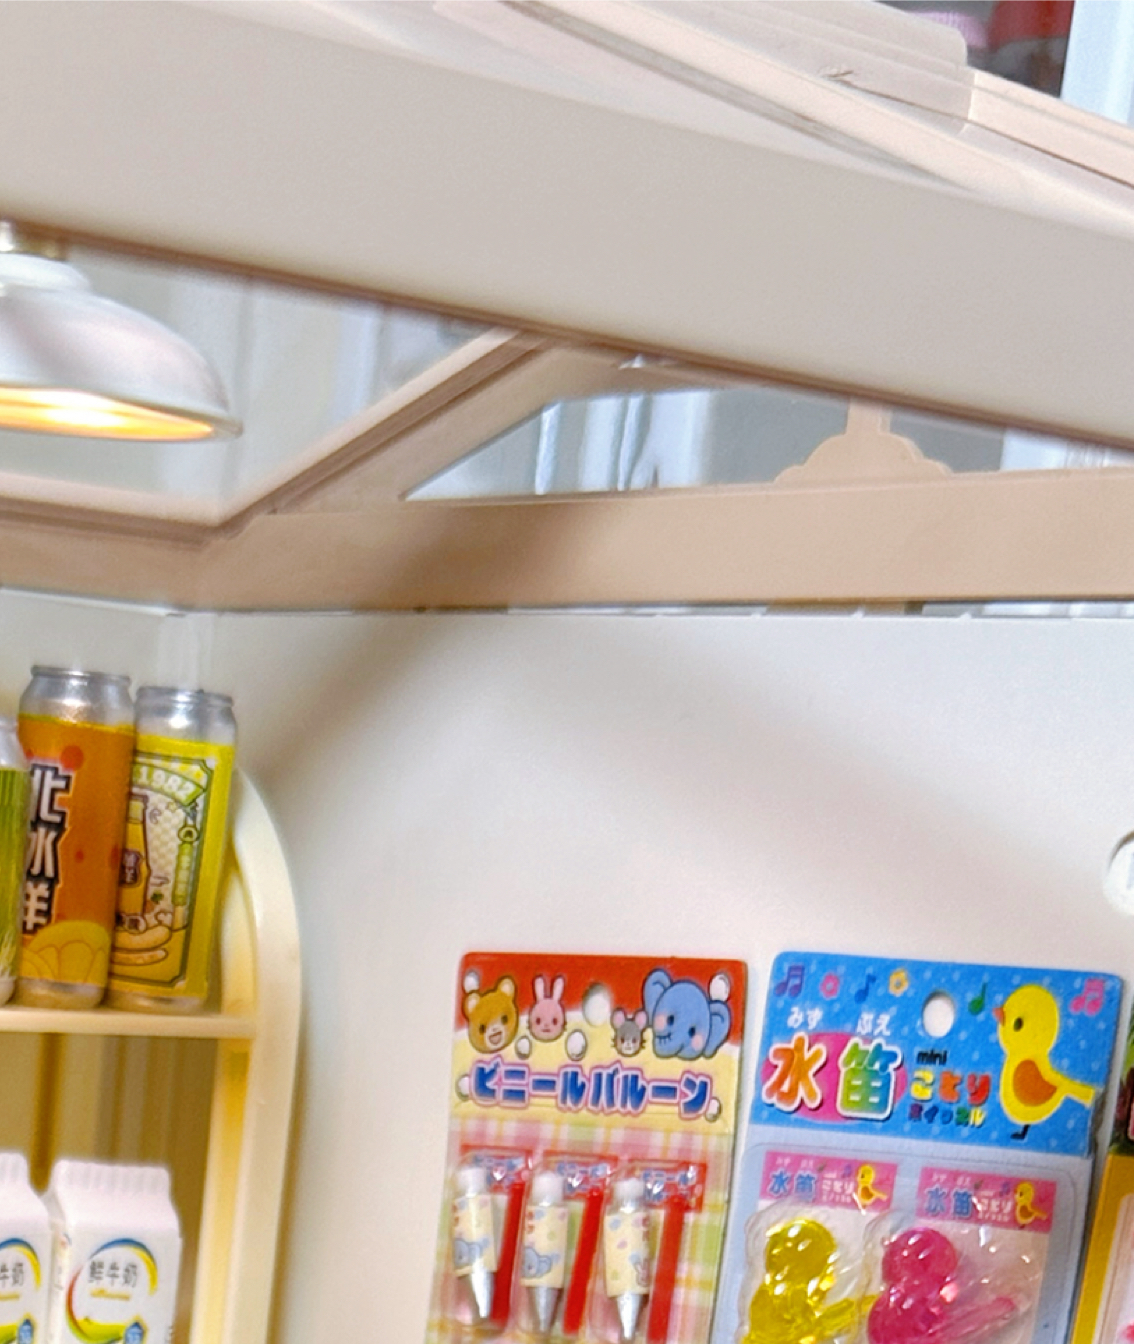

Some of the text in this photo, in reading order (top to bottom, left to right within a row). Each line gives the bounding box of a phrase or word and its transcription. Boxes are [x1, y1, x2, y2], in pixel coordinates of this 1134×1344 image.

[137, 766, 195, 799] 1982
[917, 1048, 947, 1066] mini
[469, 1057, 714, 1120] ビニールバルーン
[762, 1032, 903, 1121] 水笛
[910, 1069, 992, 1106] ことり
[769, 1169, 817, 1198] 水笛
[925, 1184, 974, 1219] 水笛
[89, 1261, 138, 1288] 鲜牛奶
